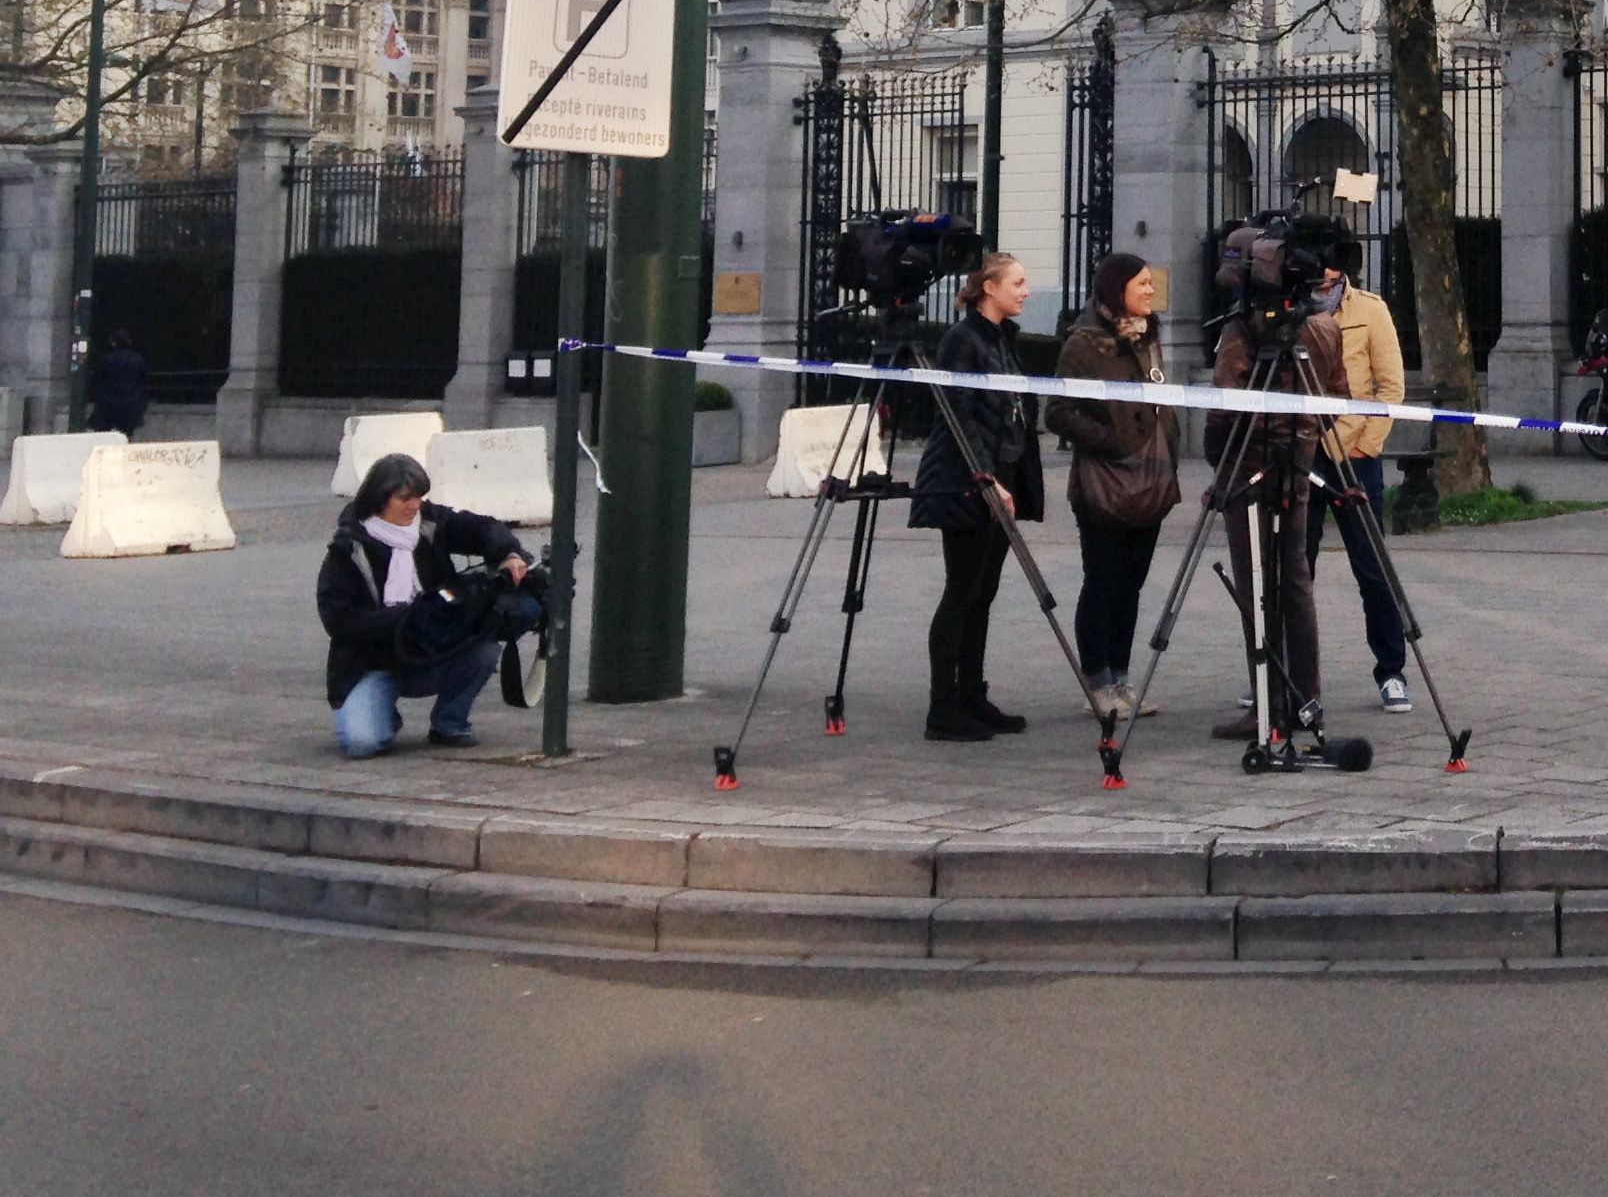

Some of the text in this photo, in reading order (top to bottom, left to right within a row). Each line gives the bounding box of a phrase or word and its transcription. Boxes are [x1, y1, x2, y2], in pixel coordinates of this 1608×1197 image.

[527, 92, 647, 121] cepté riverains
[503, 116, 665, 147] gezonderd bewoners
